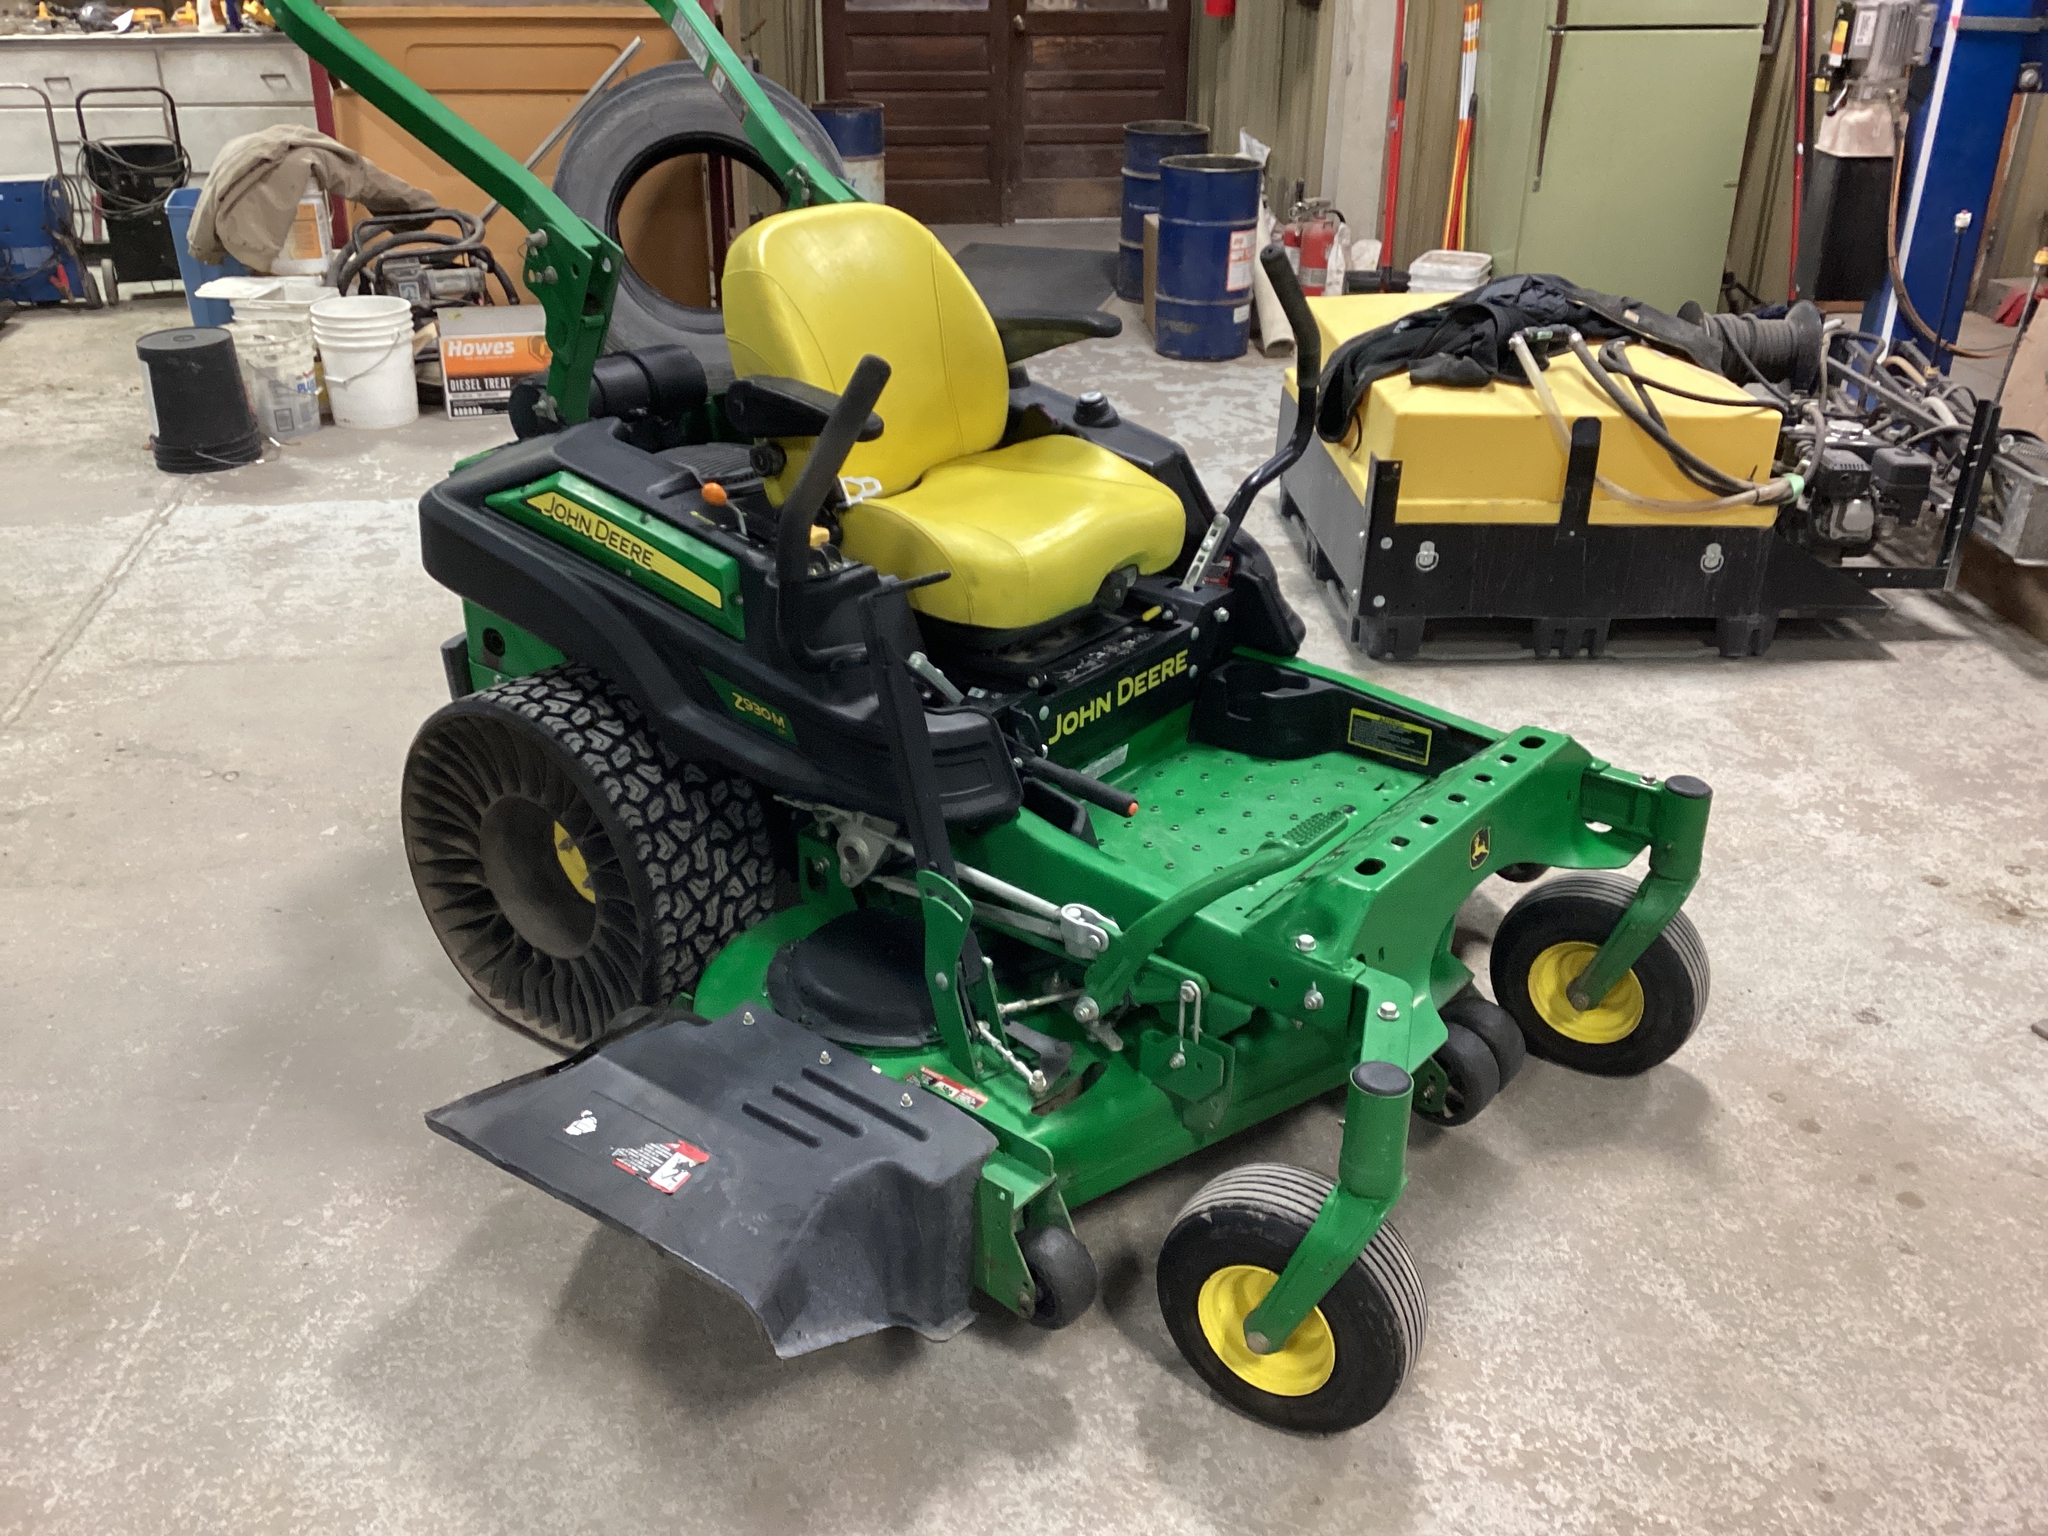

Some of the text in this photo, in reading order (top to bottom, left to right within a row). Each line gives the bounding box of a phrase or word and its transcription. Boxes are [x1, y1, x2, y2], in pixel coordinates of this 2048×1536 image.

[448, 340, 515, 357] Howes
[449, 377, 511, 391] DIESEL TREAT
[543, 496, 654, 568] JOHN DEERE
[731, 691, 786, 729] Z930M
[1048, 690, 1112, 745] JOHN
[1117, 649, 1189, 707] DEERE
